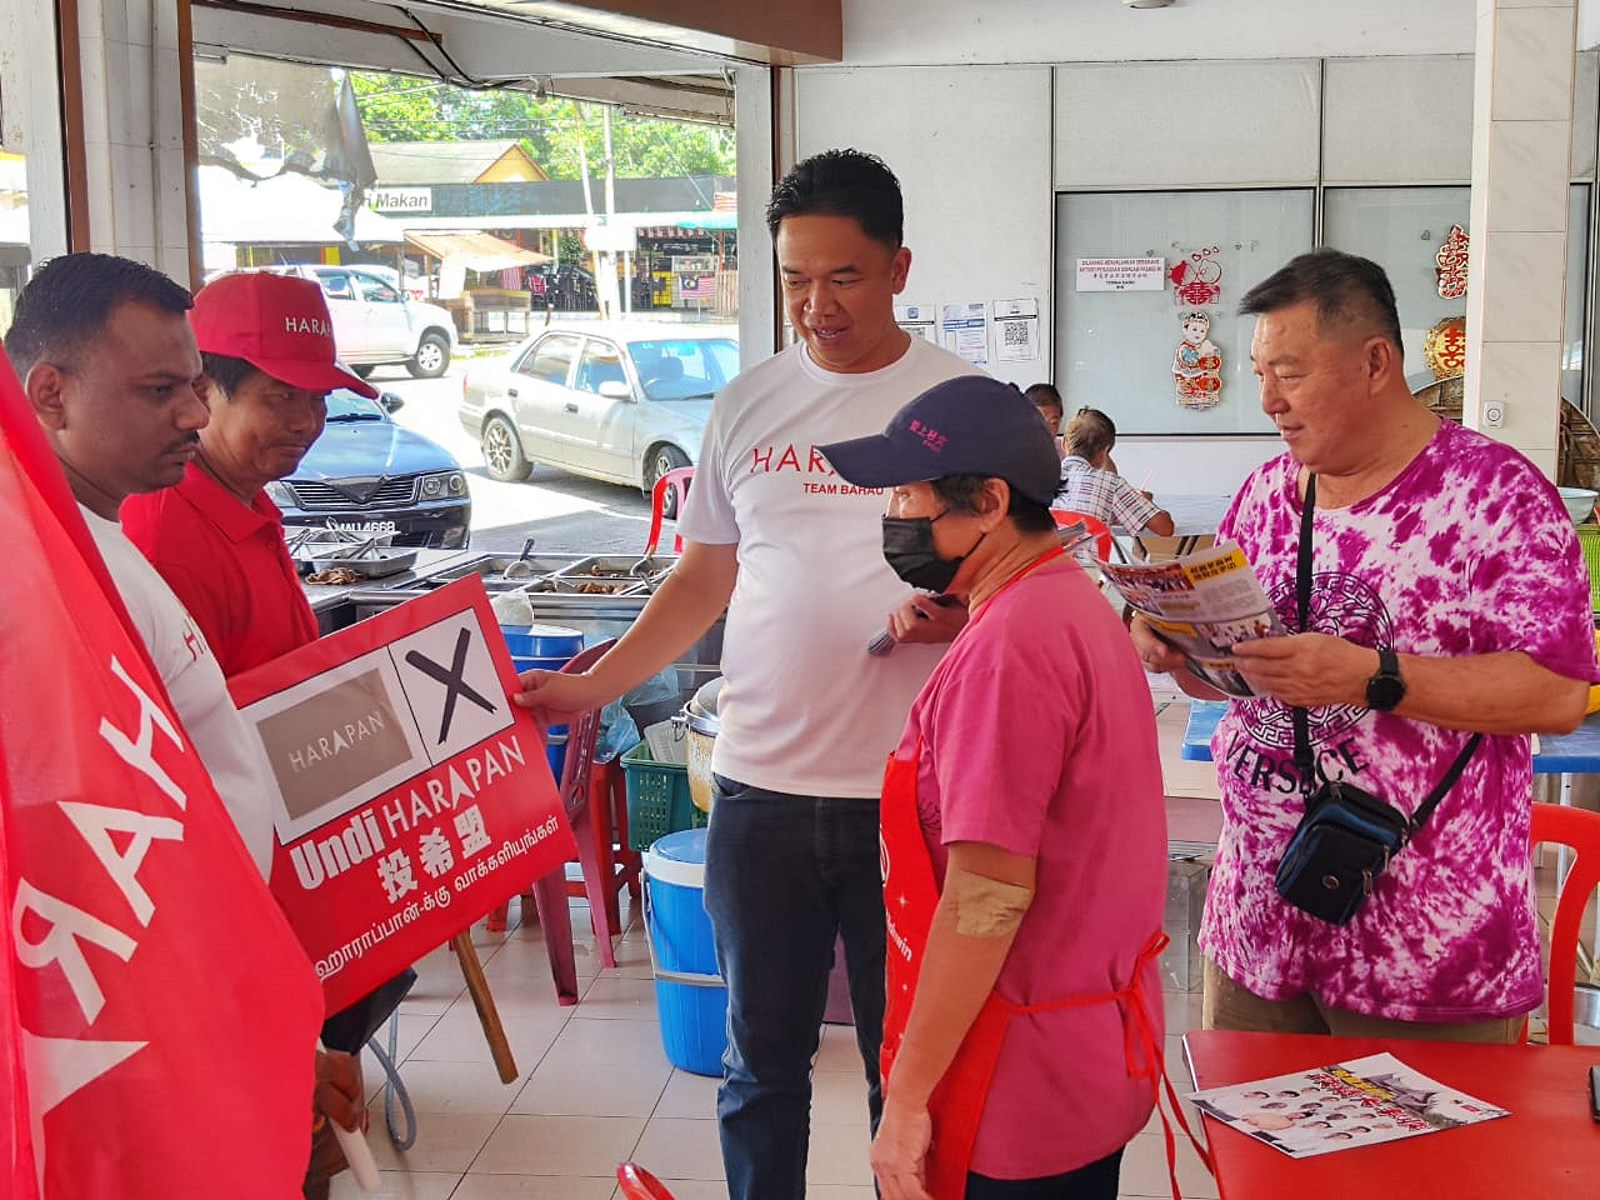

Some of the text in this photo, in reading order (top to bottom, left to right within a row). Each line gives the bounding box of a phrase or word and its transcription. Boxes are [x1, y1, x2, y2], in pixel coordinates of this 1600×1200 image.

[376, 192, 429, 209] Makan
[750, 443, 836, 477] HAR
[803, 483, 837, 495] TEAM
[287, 710, 387, 774] HARAPAN
[1226, 730, 1370, 795] VERSCE
[290, 734, 526, 891] Undi HARAPAN
[376, 803, 493, 904] 投希盟
[454, 814, 560, 893] வாக்களியுங்கள்
